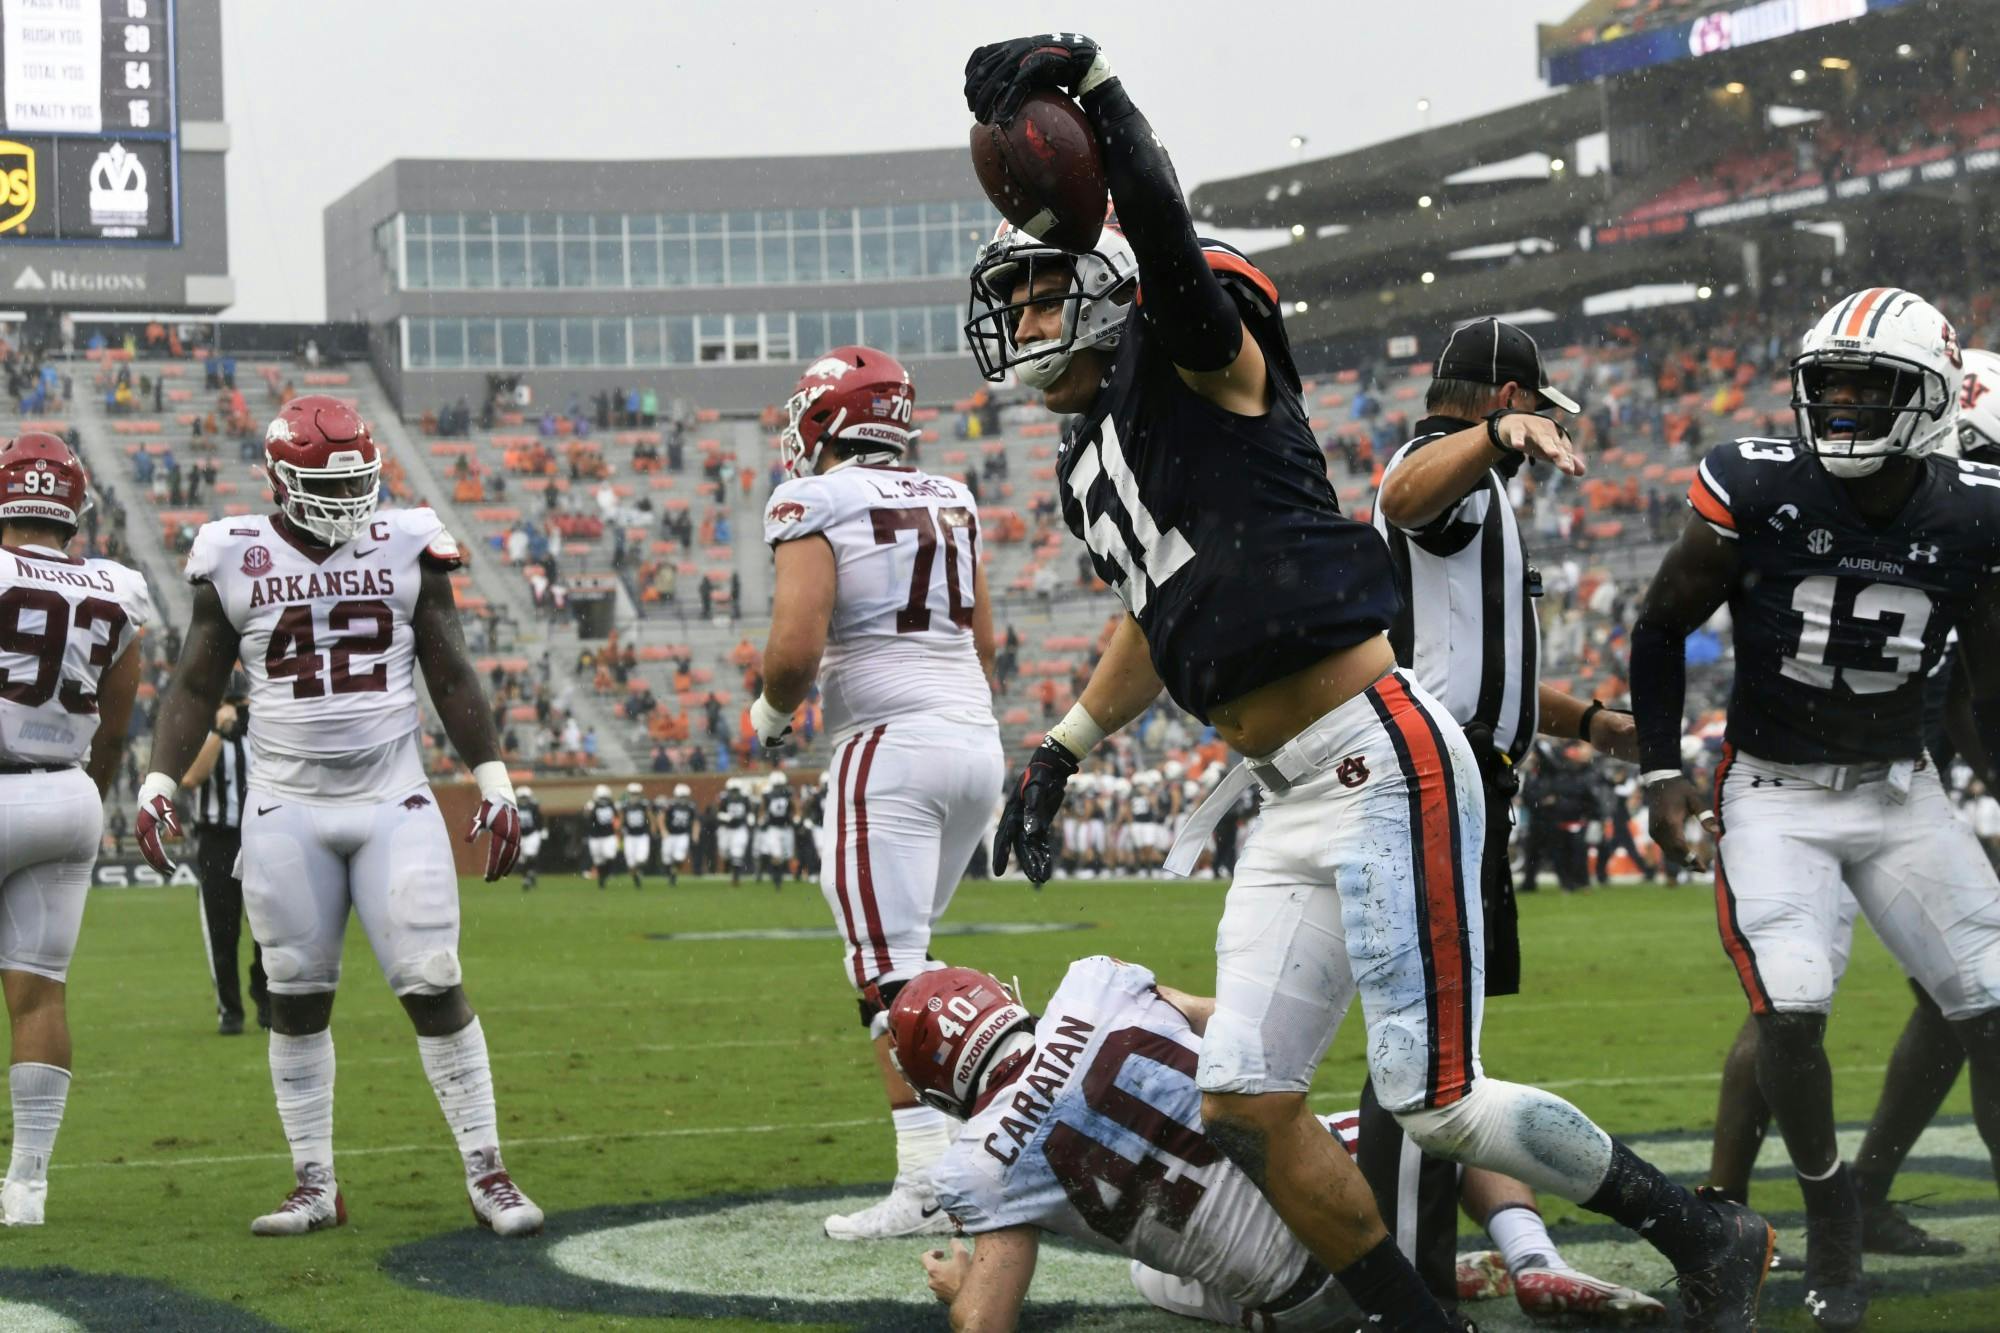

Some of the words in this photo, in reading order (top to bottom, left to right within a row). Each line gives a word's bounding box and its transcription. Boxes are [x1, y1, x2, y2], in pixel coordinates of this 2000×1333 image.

[51, 270, 147, 291] REGIONS
[890, 394, 912, 424] 70
[24, 470, 56, 496] 93
[2, 505, 71, 519] RAZORBACKS
[370, 521, 390, 541] C
[247, 546, 268, 570] SEC
[1807, 528, 1834, 554] SEC
[14, 557, 115, 593] NICHOLS
[869, 506, 977, 634] 70
[1838, 556, 1905, 576] AUBURN
[249, 568, 395, 609] ARKANSAS
[0, 586, 128, 715] 93
[265, 599, 394, 700] 42
[1778, 575, 1933, 695] 13
[938, 996, 978, 1039] 40
[957, 1008, 1018, 1084] RAZORBACKS
[984, 1015, 1095, 1167] CARATAN
[1042, 1026, 1224, 1244] 40
